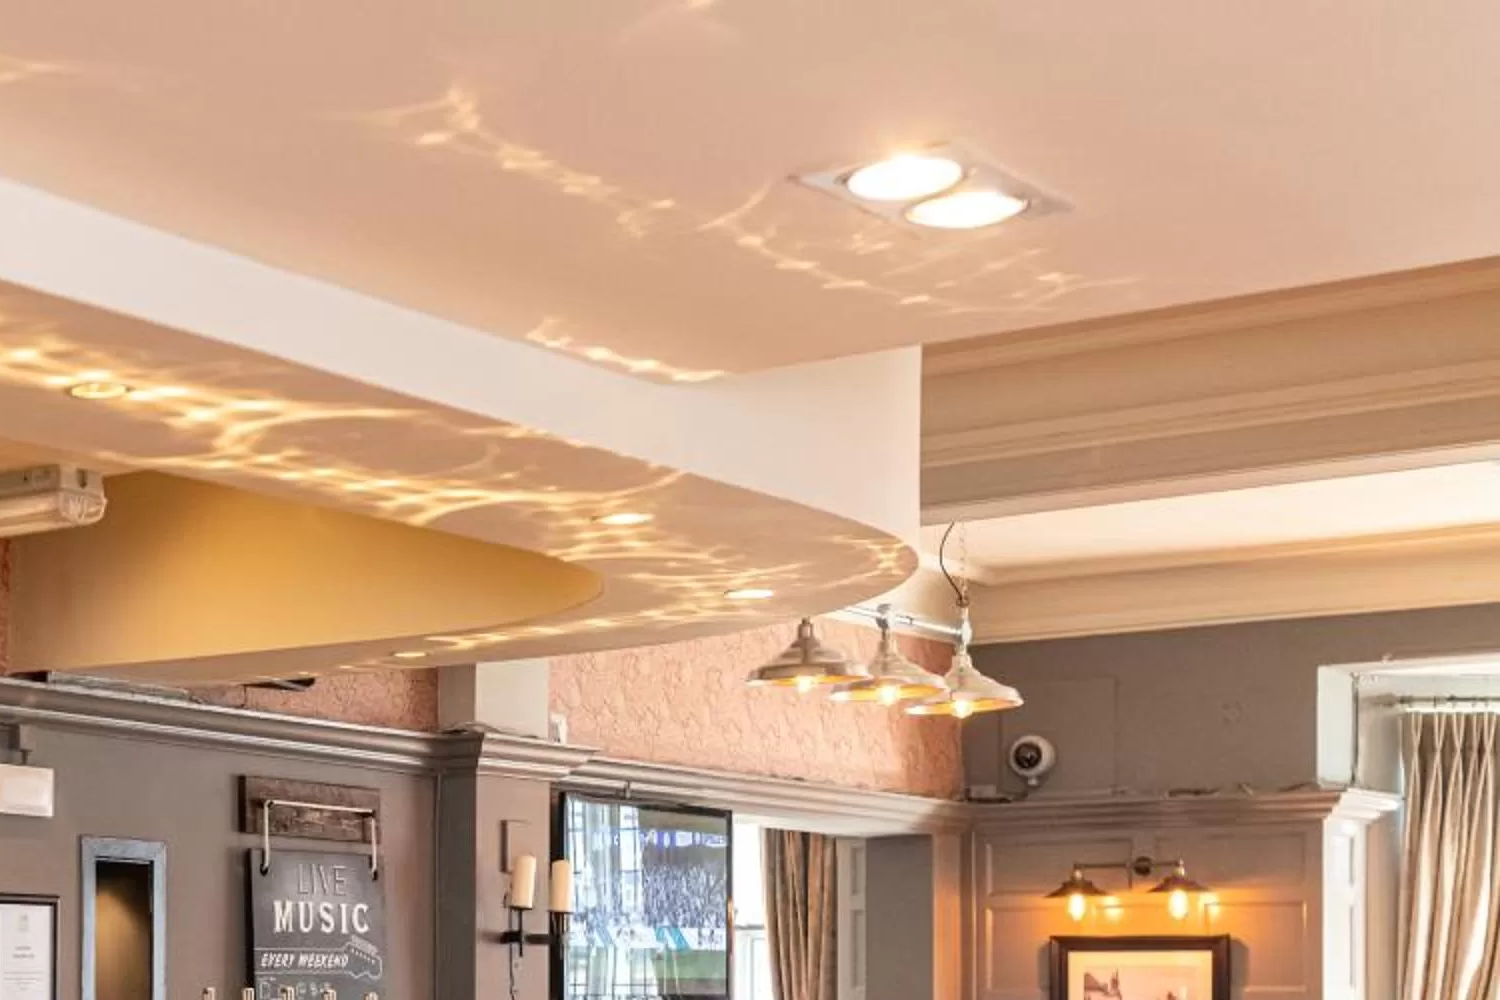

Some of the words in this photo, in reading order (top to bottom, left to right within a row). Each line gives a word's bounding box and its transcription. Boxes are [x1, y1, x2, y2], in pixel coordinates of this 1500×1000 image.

[297, 863, 348, 897] LIVE
[272, 899, 371, 934] MUSIC
[260, 952, 295, 968] EVERY
[297, 952, 350, 969] WEEKEND
